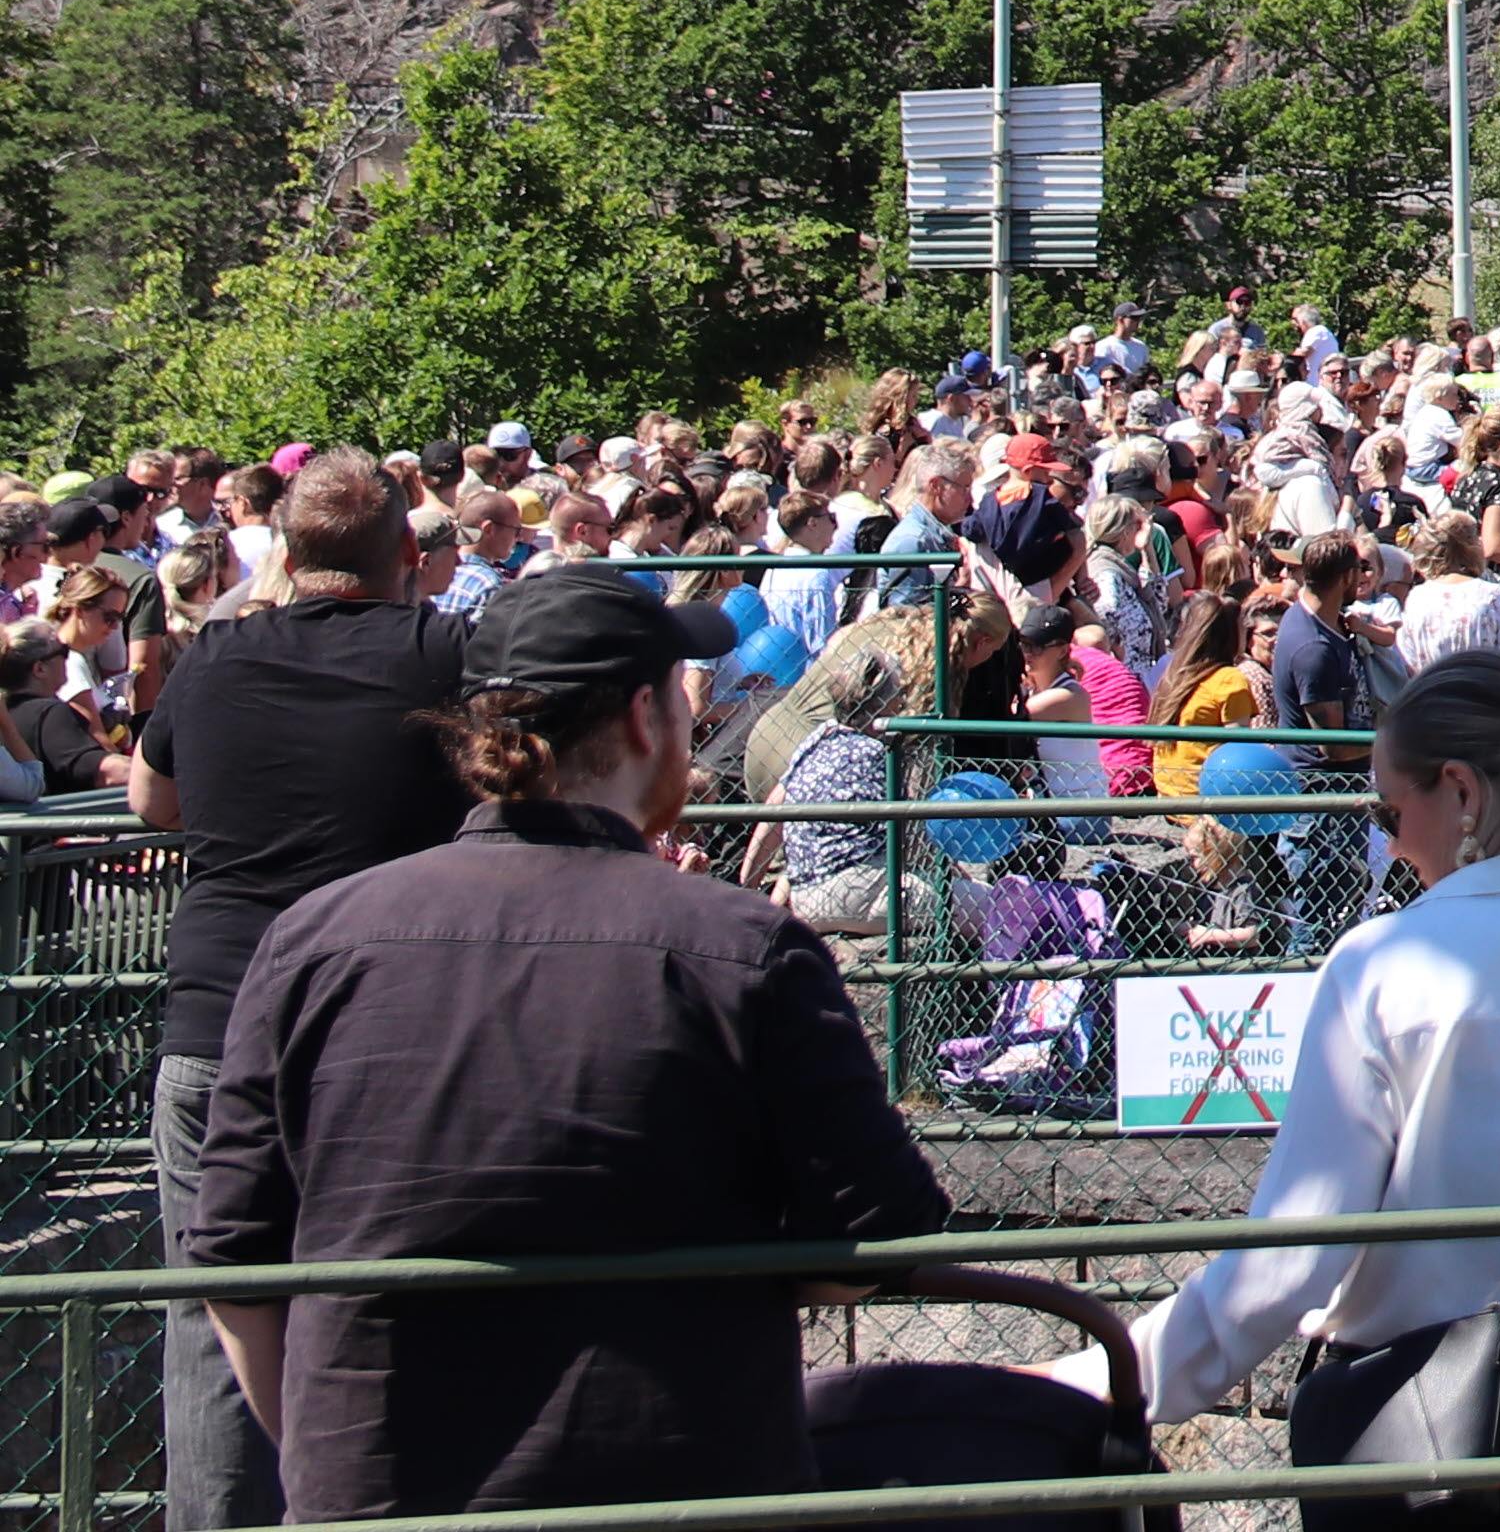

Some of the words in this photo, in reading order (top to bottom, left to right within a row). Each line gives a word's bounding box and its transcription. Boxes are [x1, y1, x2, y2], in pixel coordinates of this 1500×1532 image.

[1169, 1008, 1286, 1041] CYKEL
[1169, 1048, 1284, 1068] PARKERING
[1169, 1074, 1285, 1096] FÖRBJUDEN
